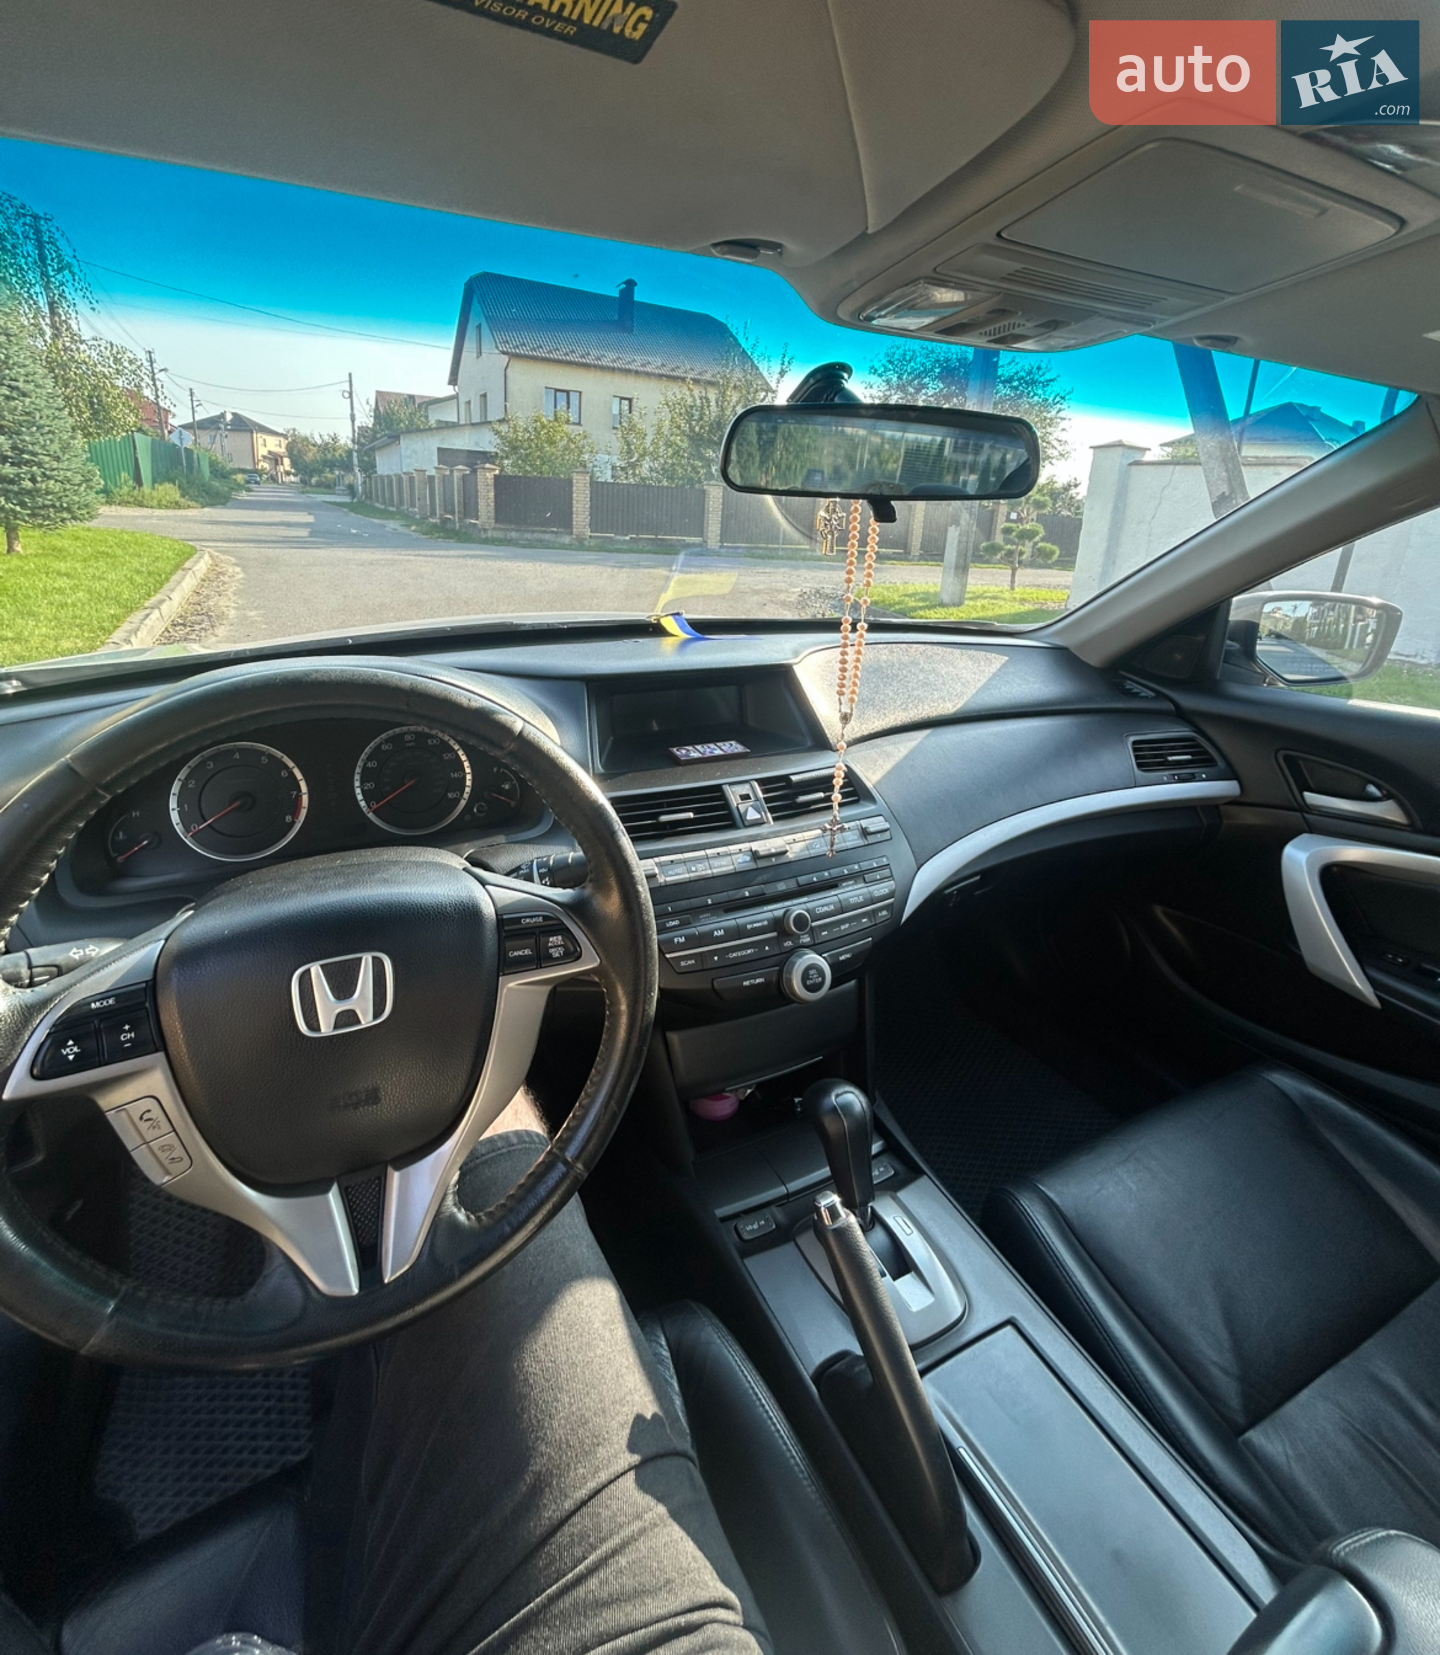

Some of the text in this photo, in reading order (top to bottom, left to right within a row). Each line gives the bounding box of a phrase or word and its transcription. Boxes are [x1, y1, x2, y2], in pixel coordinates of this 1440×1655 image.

[473, 0, 578, 36] VISOR OVER
[516, 0, 653, 41] RNING
[404, 733, 416, 741] 80
[261, 756, 268, 764] 5
[442, 752, 456, 760] 120
[206, 761, 214, 769] 3
[366, 760, 377, 768] 40
[281, 769, 288, 777] 6
[188, 780, 196, 788] 2
[290, 791, 297, 799] 7
[447, 791, 460, 799] 160
[285, 815, 293, 823] 8
[521, 916, 544, 925] CRUISE
[713, 929, 725, 937] AM
[674, 936, 686, 944] FM
[508, 949, 533, 957] CANCEL
[680, 959, 696, 967] SCAN
[742, 977, 765, 987] RETURN
[806, 977, 822, 985] ENTER
[90, 997, 116, 1009] MODE
[120, 1031, 135, 1041] CH
[61, 1045, 82, 1055] VOL
